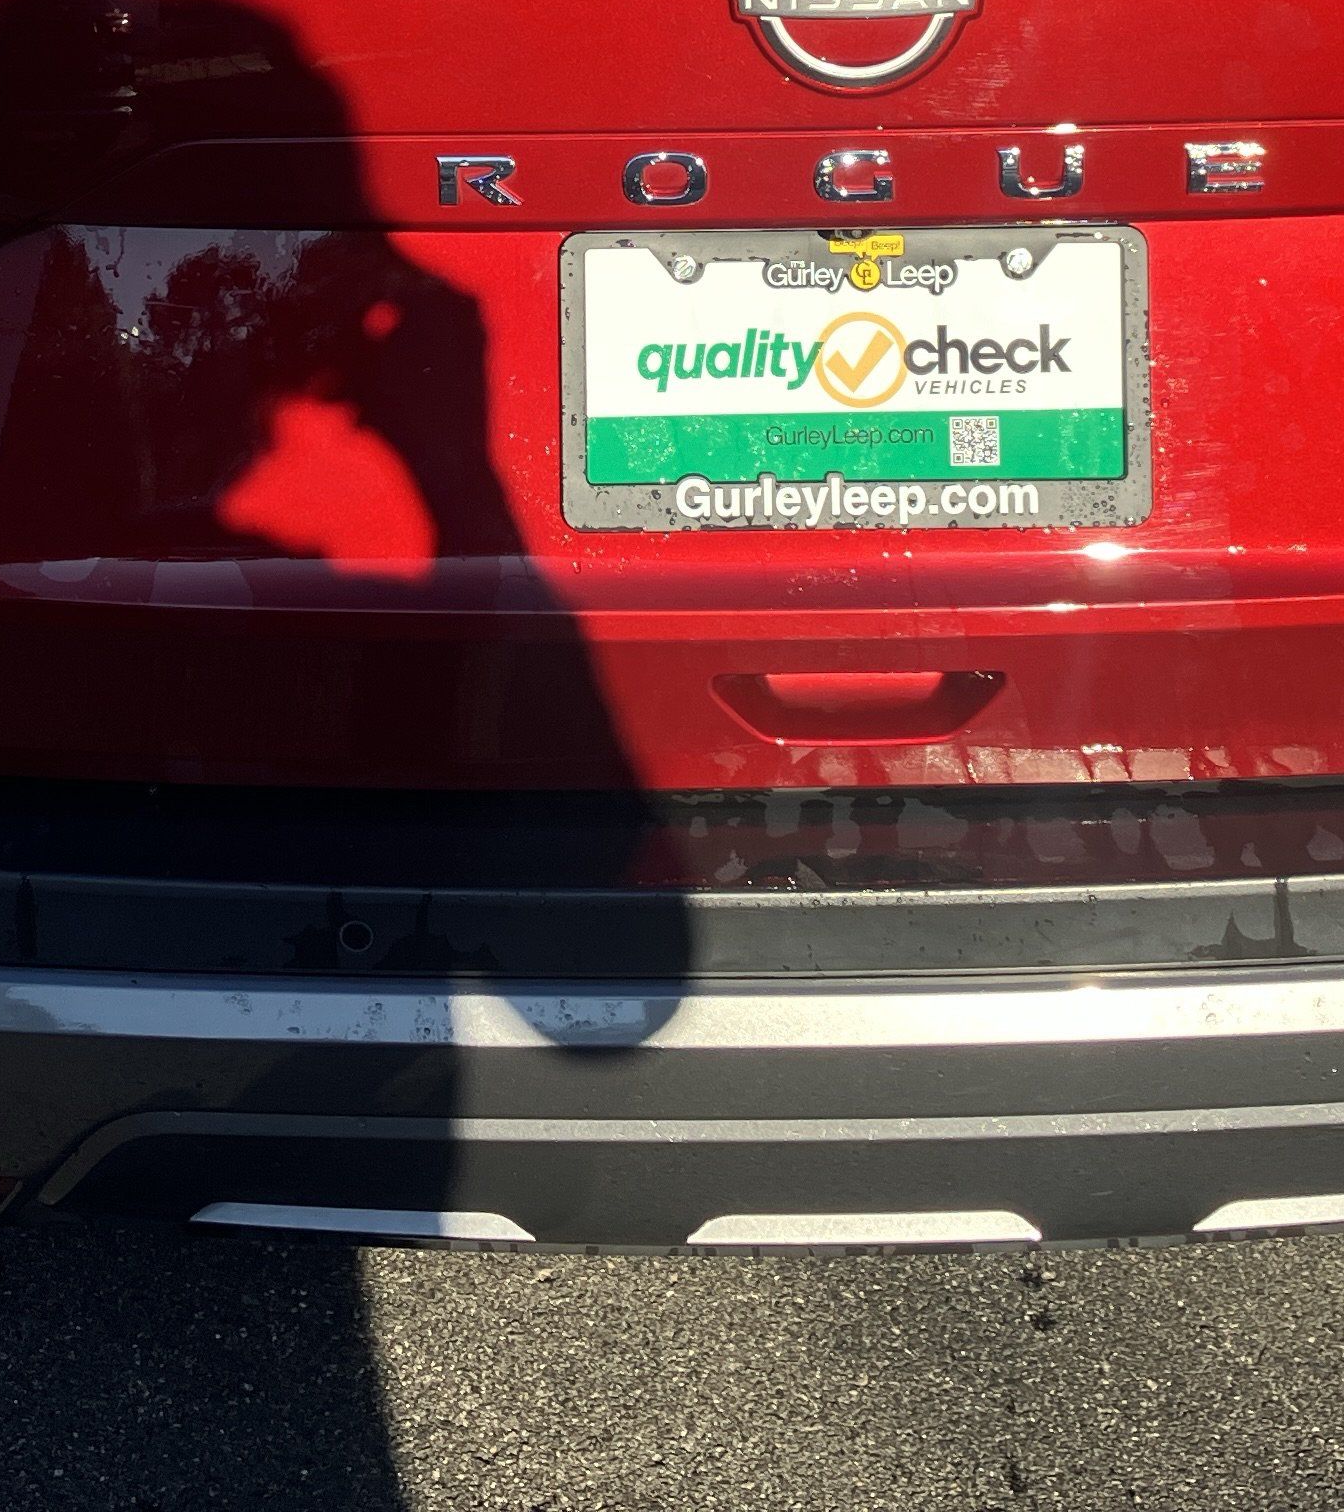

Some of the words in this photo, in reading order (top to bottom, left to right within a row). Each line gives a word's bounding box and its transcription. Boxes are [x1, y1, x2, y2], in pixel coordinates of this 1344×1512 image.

[437, 142, 1265, 207] ROGUE
[767, 261, 844, 292] Gurley
[887, 260, 953, 292] Leep
[637, 328, 824, 392] quality
[903, 324, 1072, 374] check
[914, 379, 1028, 395] VEHICLES
[765, 425, 935, 450] GurleyLeep.com
[676, 479, 1040, 527] Gurleyleep.com
